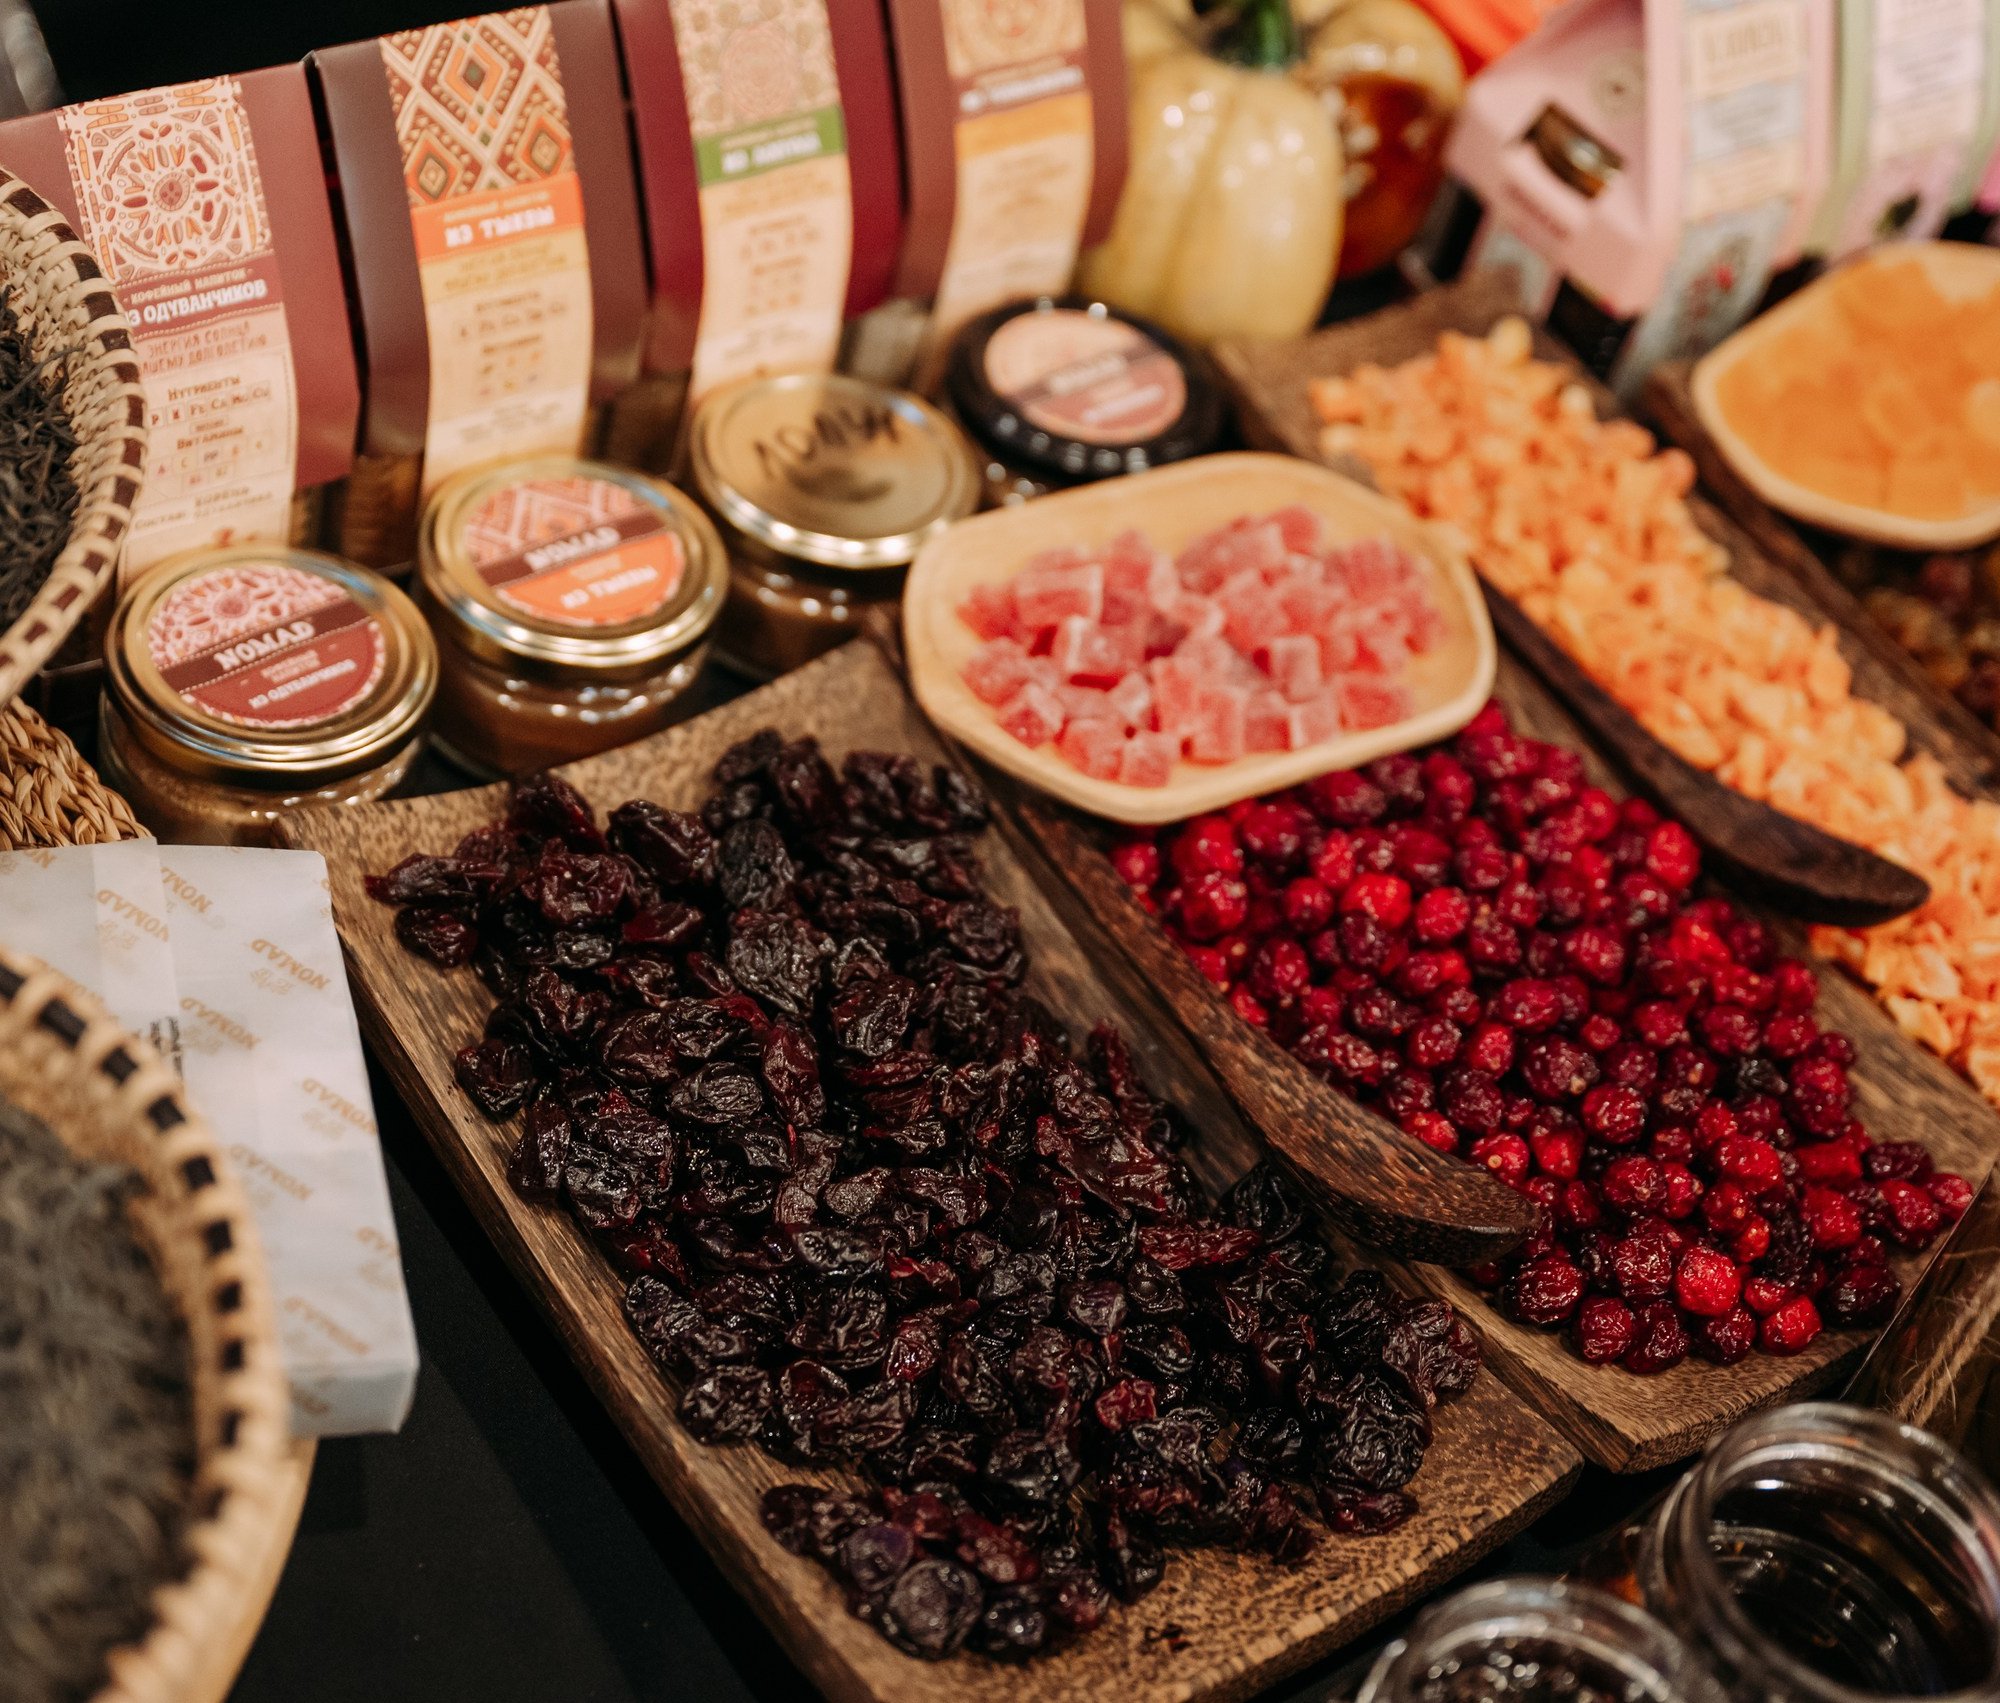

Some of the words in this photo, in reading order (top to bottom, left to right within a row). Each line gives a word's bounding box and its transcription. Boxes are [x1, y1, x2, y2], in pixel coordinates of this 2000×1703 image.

[143, 278, 268, 325] ОДУВАНЧИКОВ
[213, 621, 316, 671] NOMAD
[97, 888, 169, 942] NOMAD
[251, 938, 331, 990] NOMAD
[180, 996, 262, 1050] NOMAD
